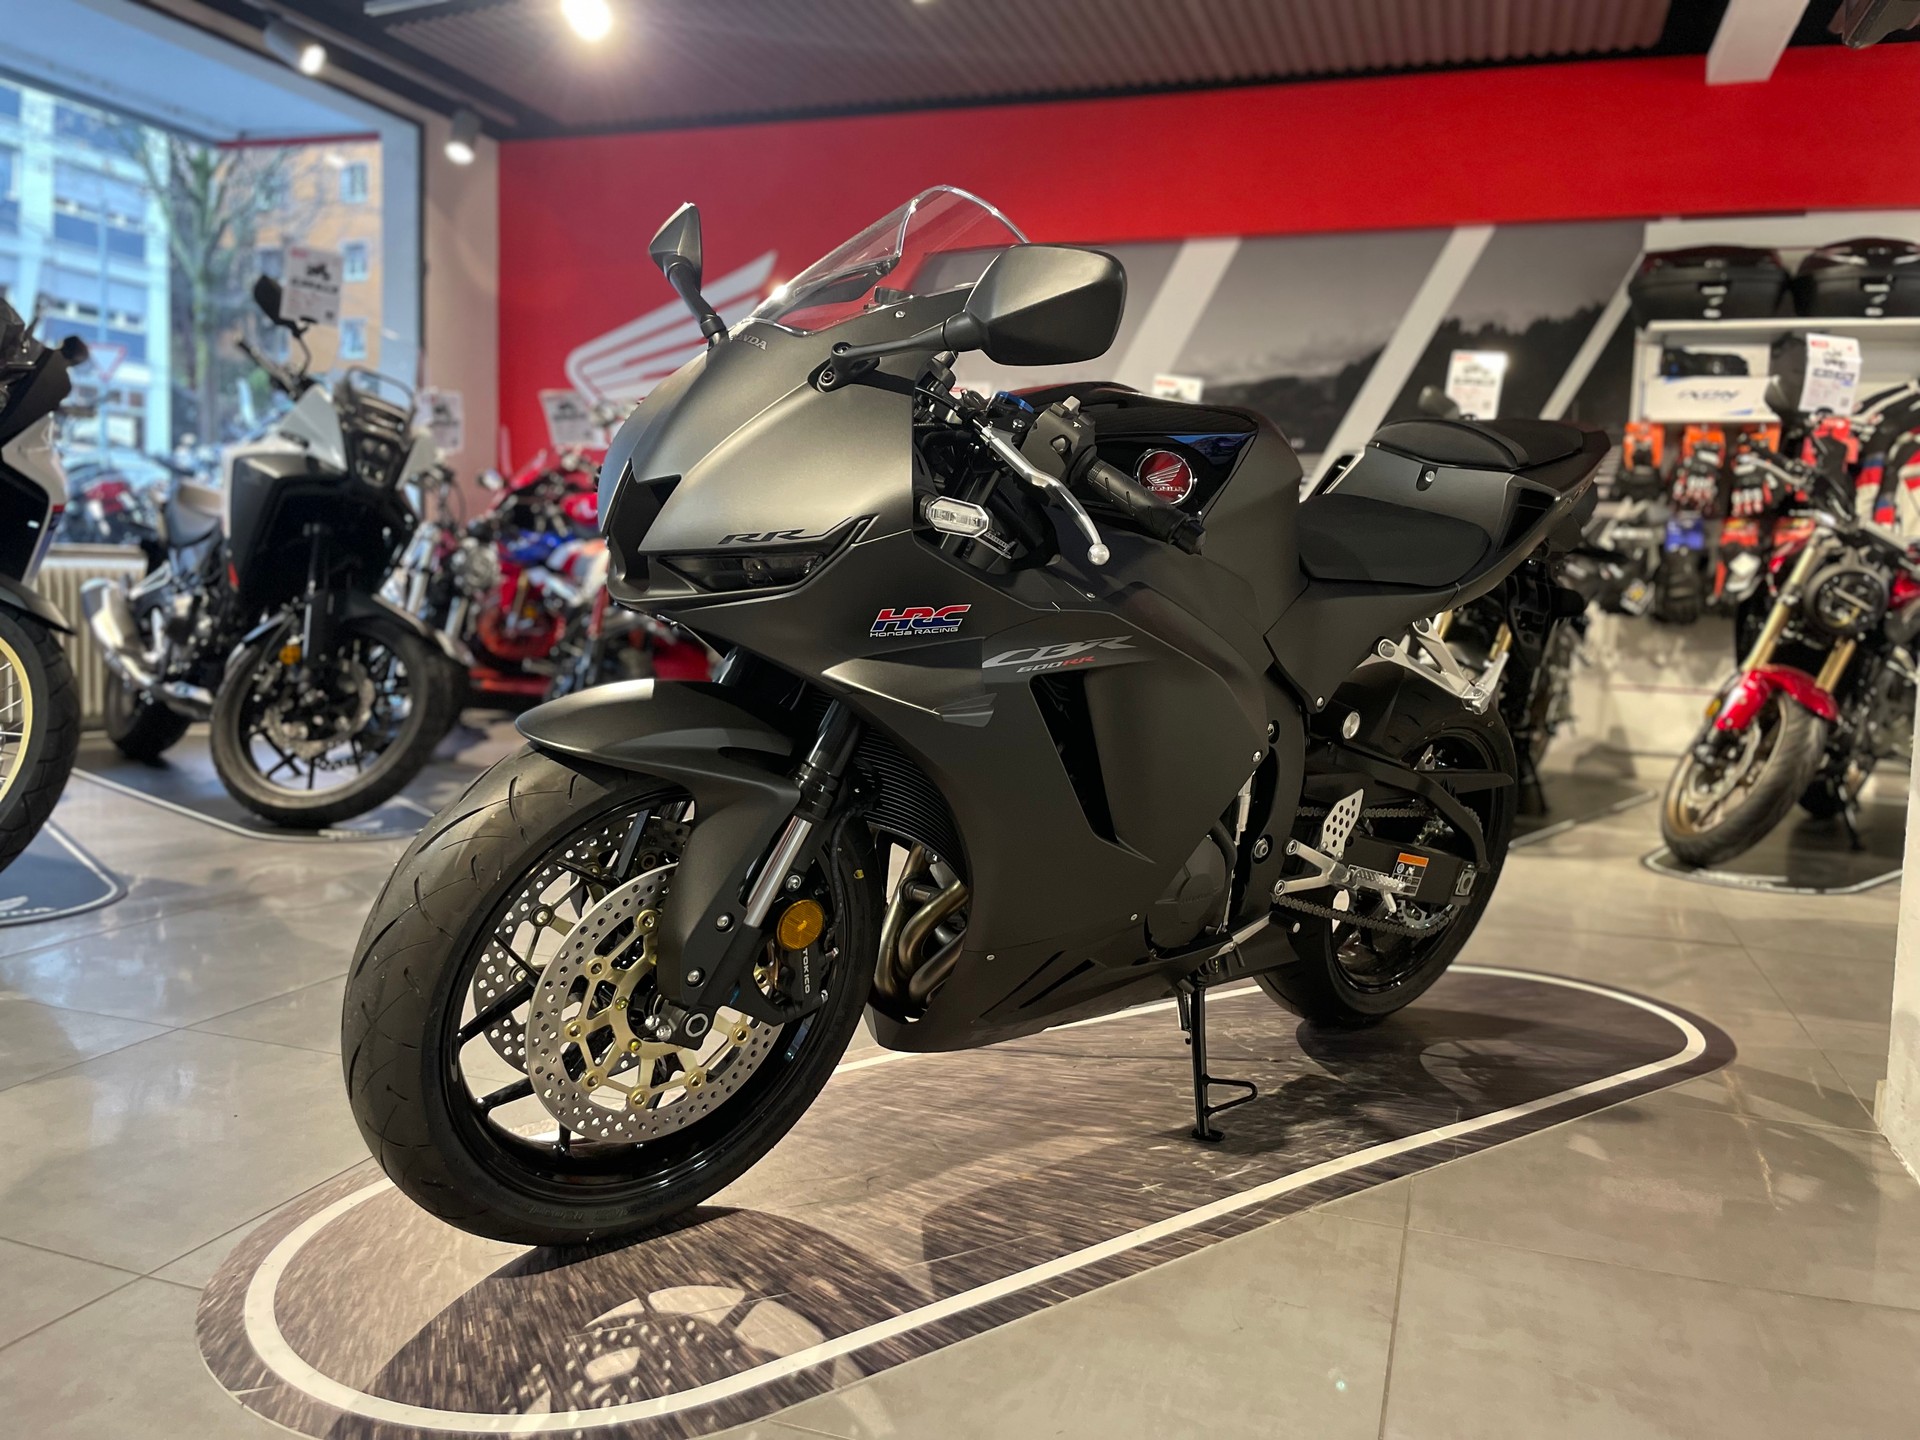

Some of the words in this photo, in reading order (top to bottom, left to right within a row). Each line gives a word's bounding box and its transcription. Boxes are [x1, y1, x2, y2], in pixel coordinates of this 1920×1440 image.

[718, 529, 806, 545] RR
[870, 604, 972, 632] HRC
[869, 630, 912, 643] Honda
[914, 626, 959, 640] RACING
[981, 635, 1137, 669] CBR
[1016, 655, 1096, 673] 600RR
[802, 947, 811, 994] TOKICO
